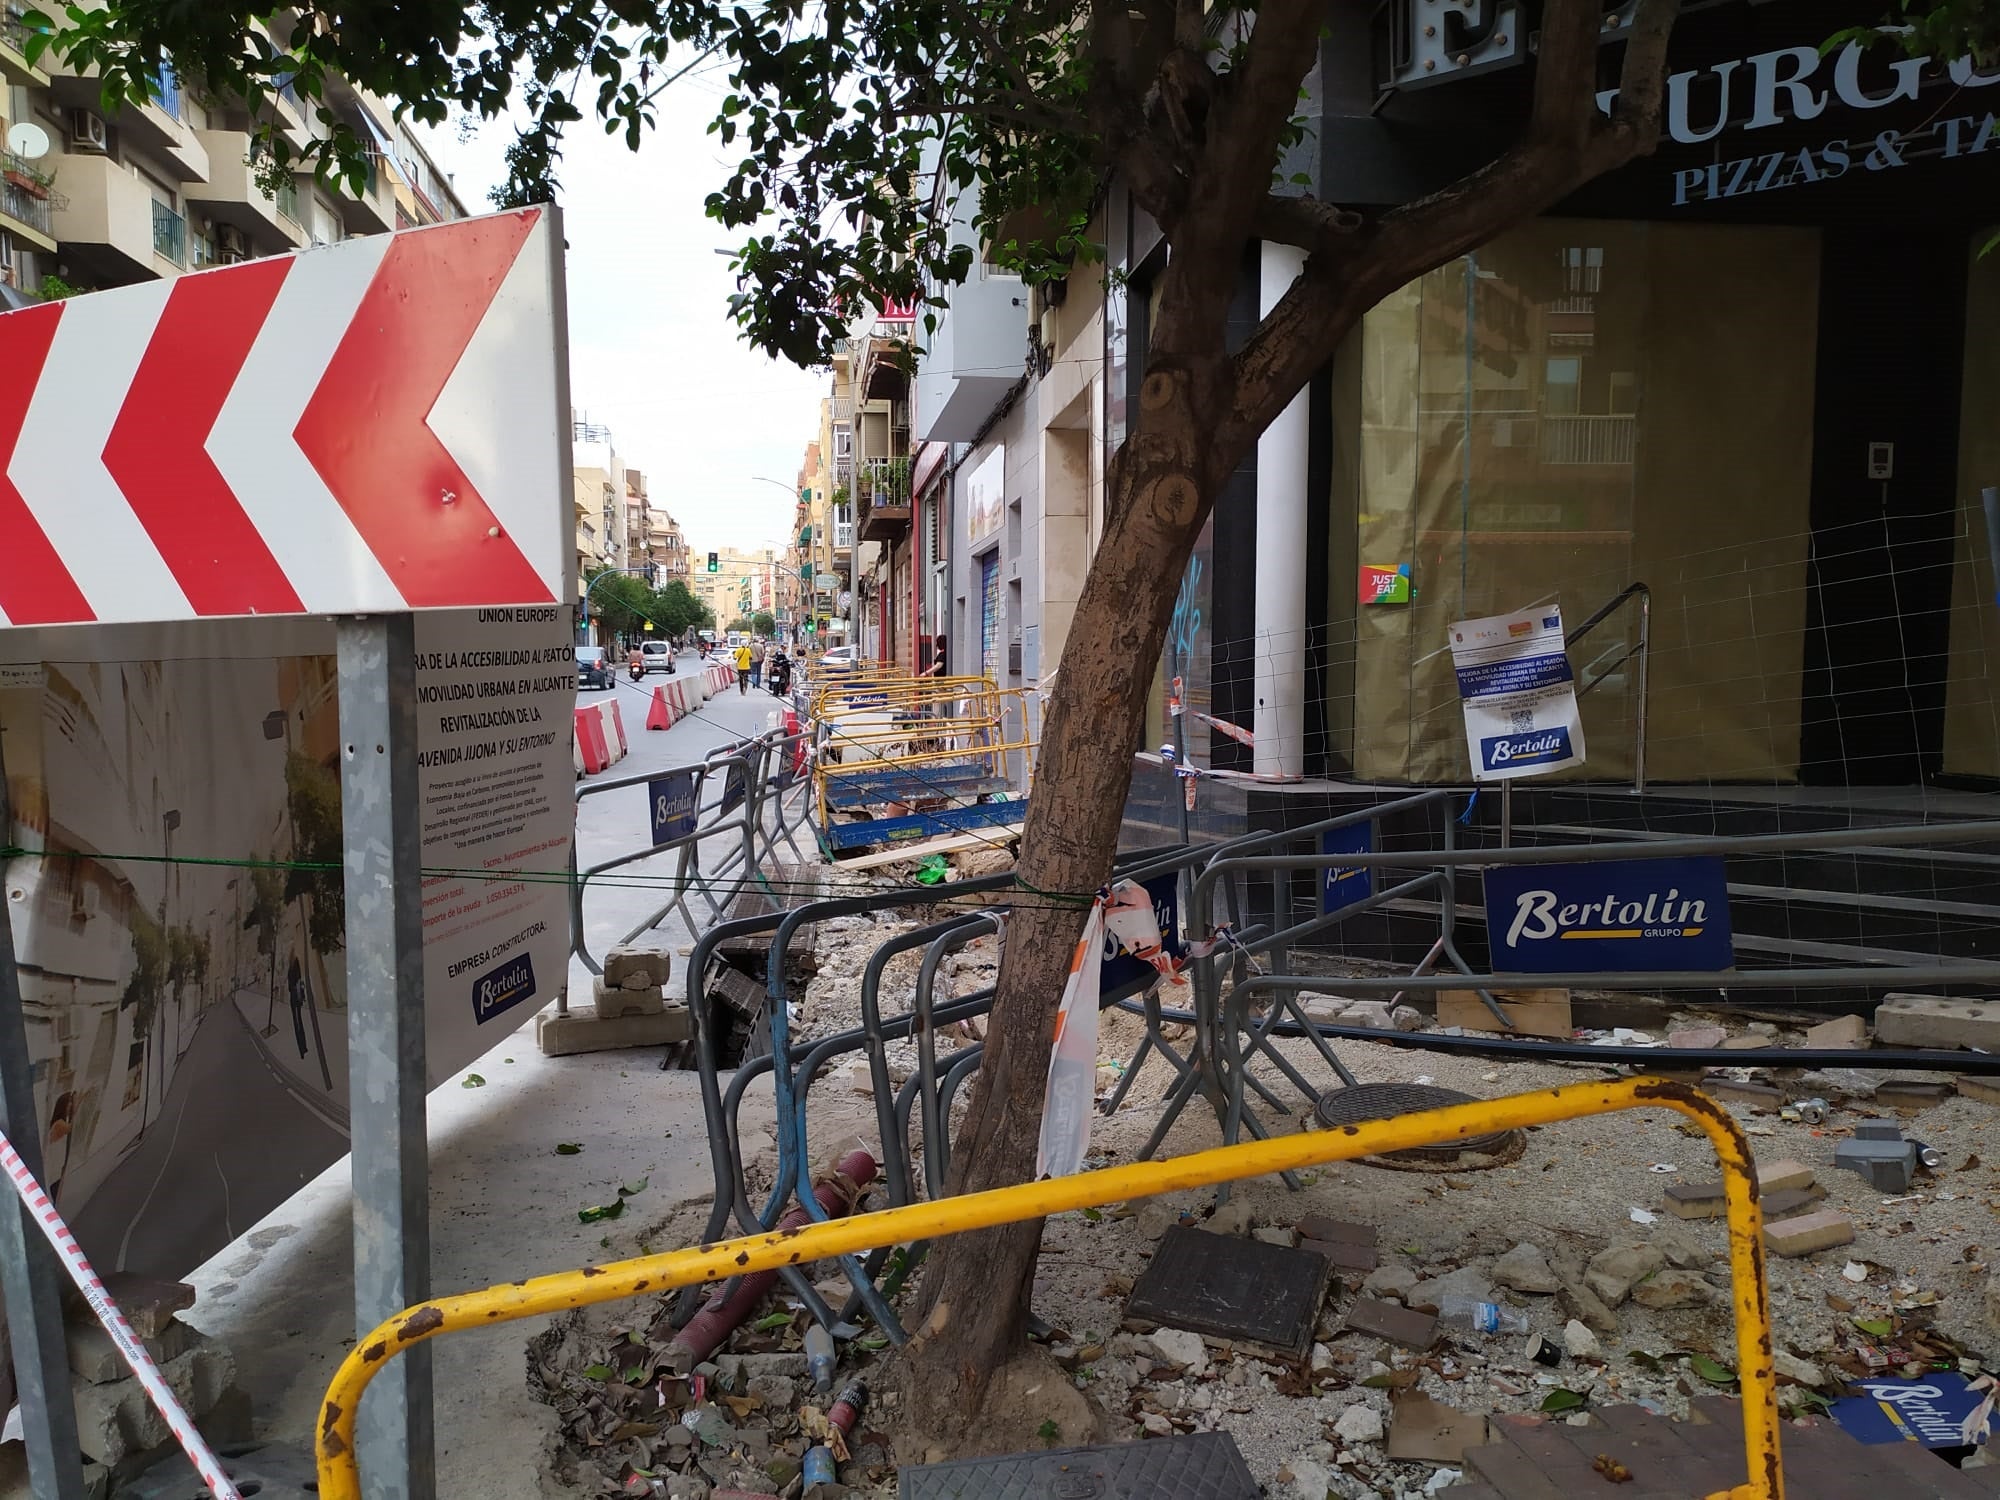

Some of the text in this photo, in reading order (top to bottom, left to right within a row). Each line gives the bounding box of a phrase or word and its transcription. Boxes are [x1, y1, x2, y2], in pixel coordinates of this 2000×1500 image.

[1596, 25, 2000, 144] URG
[1671, 140, 1850, 206] PIZZAS
[1864, 129, 1911, 172] &
[1371, 575, 1397, 585] JUST
[1377, 585, 1397, 594] EAT
[430, 653, 442, 669] DE
[445, 652, 457, 668] LA
[461, 649, 530, 667] ACCESIBILIDAD
[532, 649, 541, 663] AL
[418, 676, 574, 703] MOVILIDAD URBANA EN ALICANTE
[440, 707, 541, 733] REVITALIZACIÓN DE LA
[417, 732, 555, 768] AVENIDA JIJONA Y SU ENTORNO
[1506, 888, 1708, 948] Bertolín
[1644, 928, 1681, 938] GRUPO
[448, 950, 490, 978] EMPRESA
